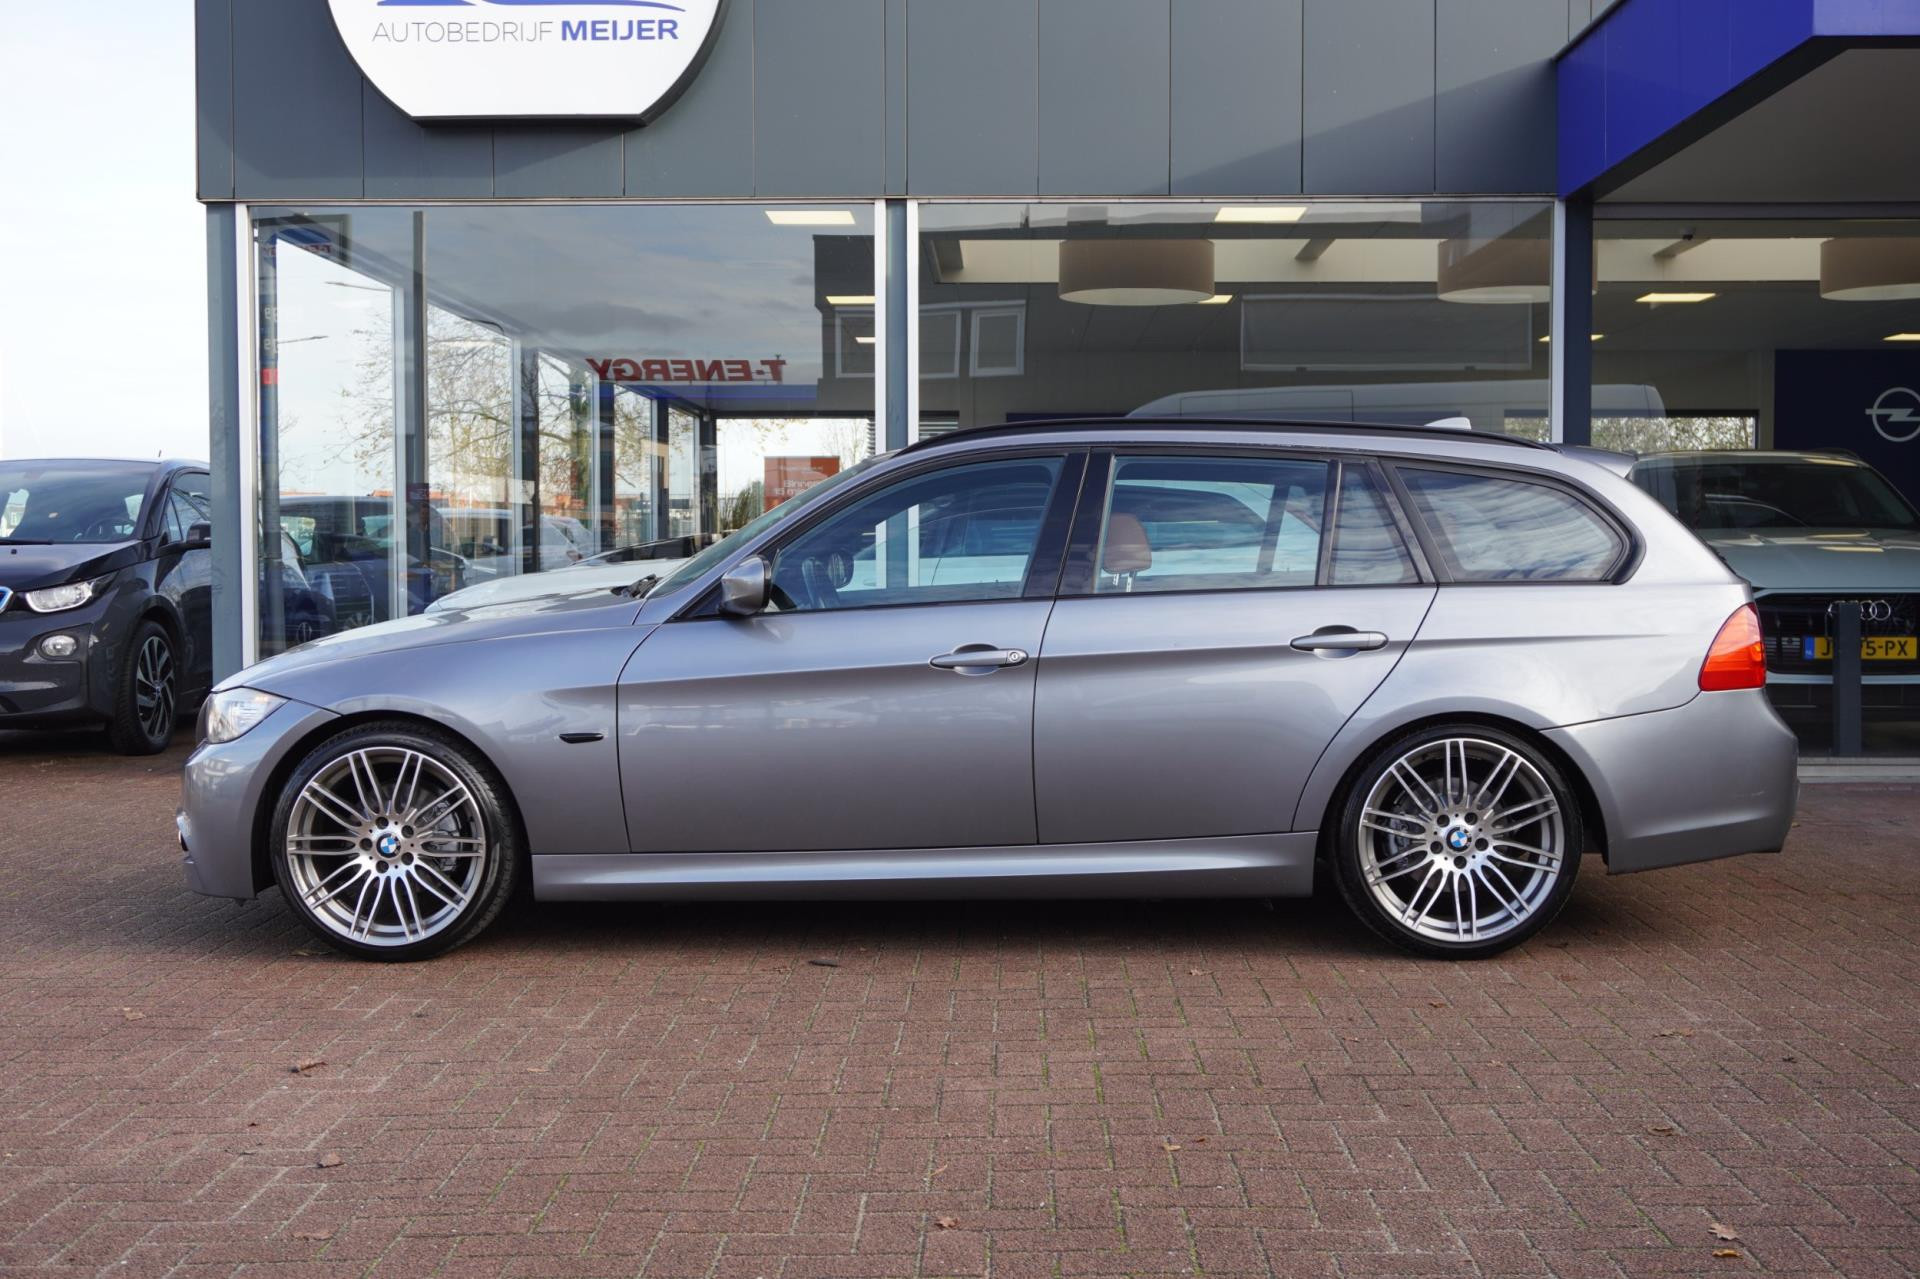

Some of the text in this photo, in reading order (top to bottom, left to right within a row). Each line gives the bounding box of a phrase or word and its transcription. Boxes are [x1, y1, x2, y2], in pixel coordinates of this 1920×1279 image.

[372, 19, 679, 42] AUTOBEDRIJF MEIJER
[1821, 638, 1908, 657] J5-PX
